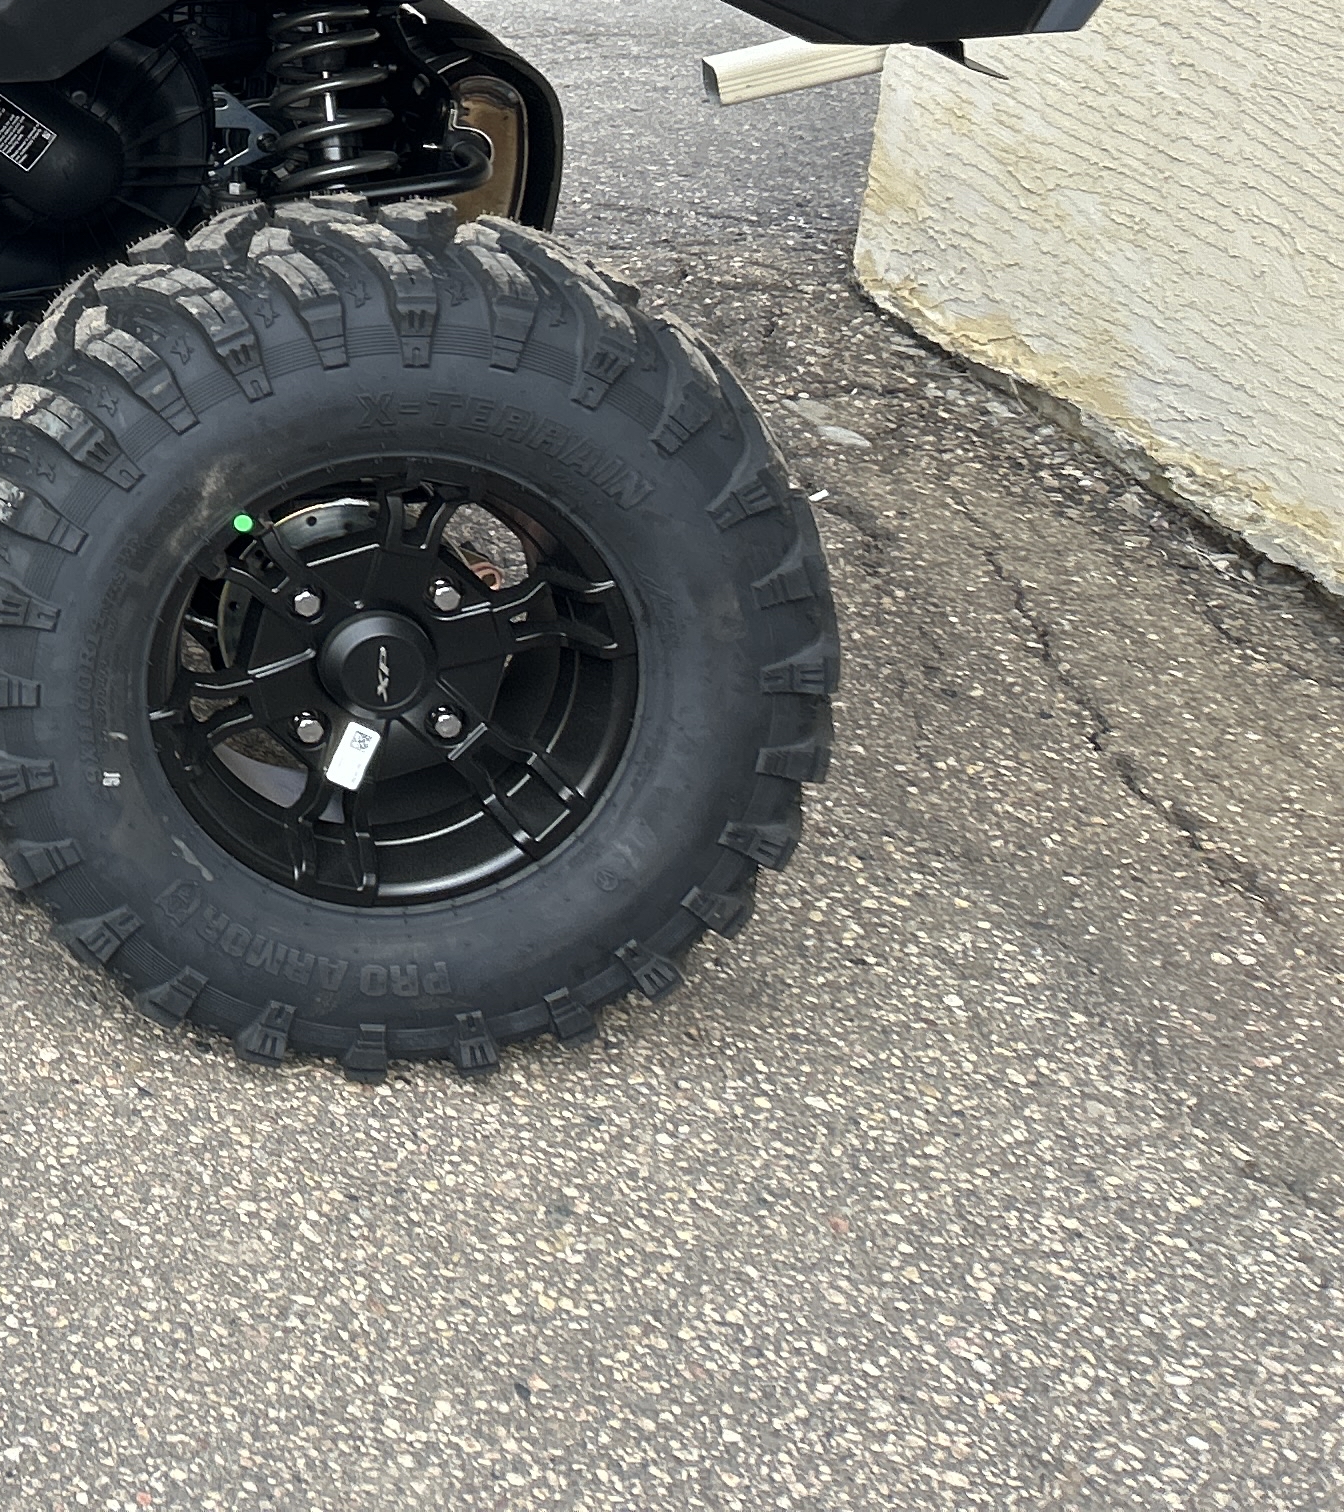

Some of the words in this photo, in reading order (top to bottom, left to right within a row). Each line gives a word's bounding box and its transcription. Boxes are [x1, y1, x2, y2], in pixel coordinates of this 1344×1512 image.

[357, 392, 658, 511] X-TERRAIN
[376, 646, 390, 703] XP
[196, 904, 349, 993] ARMOR
[360, 961, 451, 997] PRO
